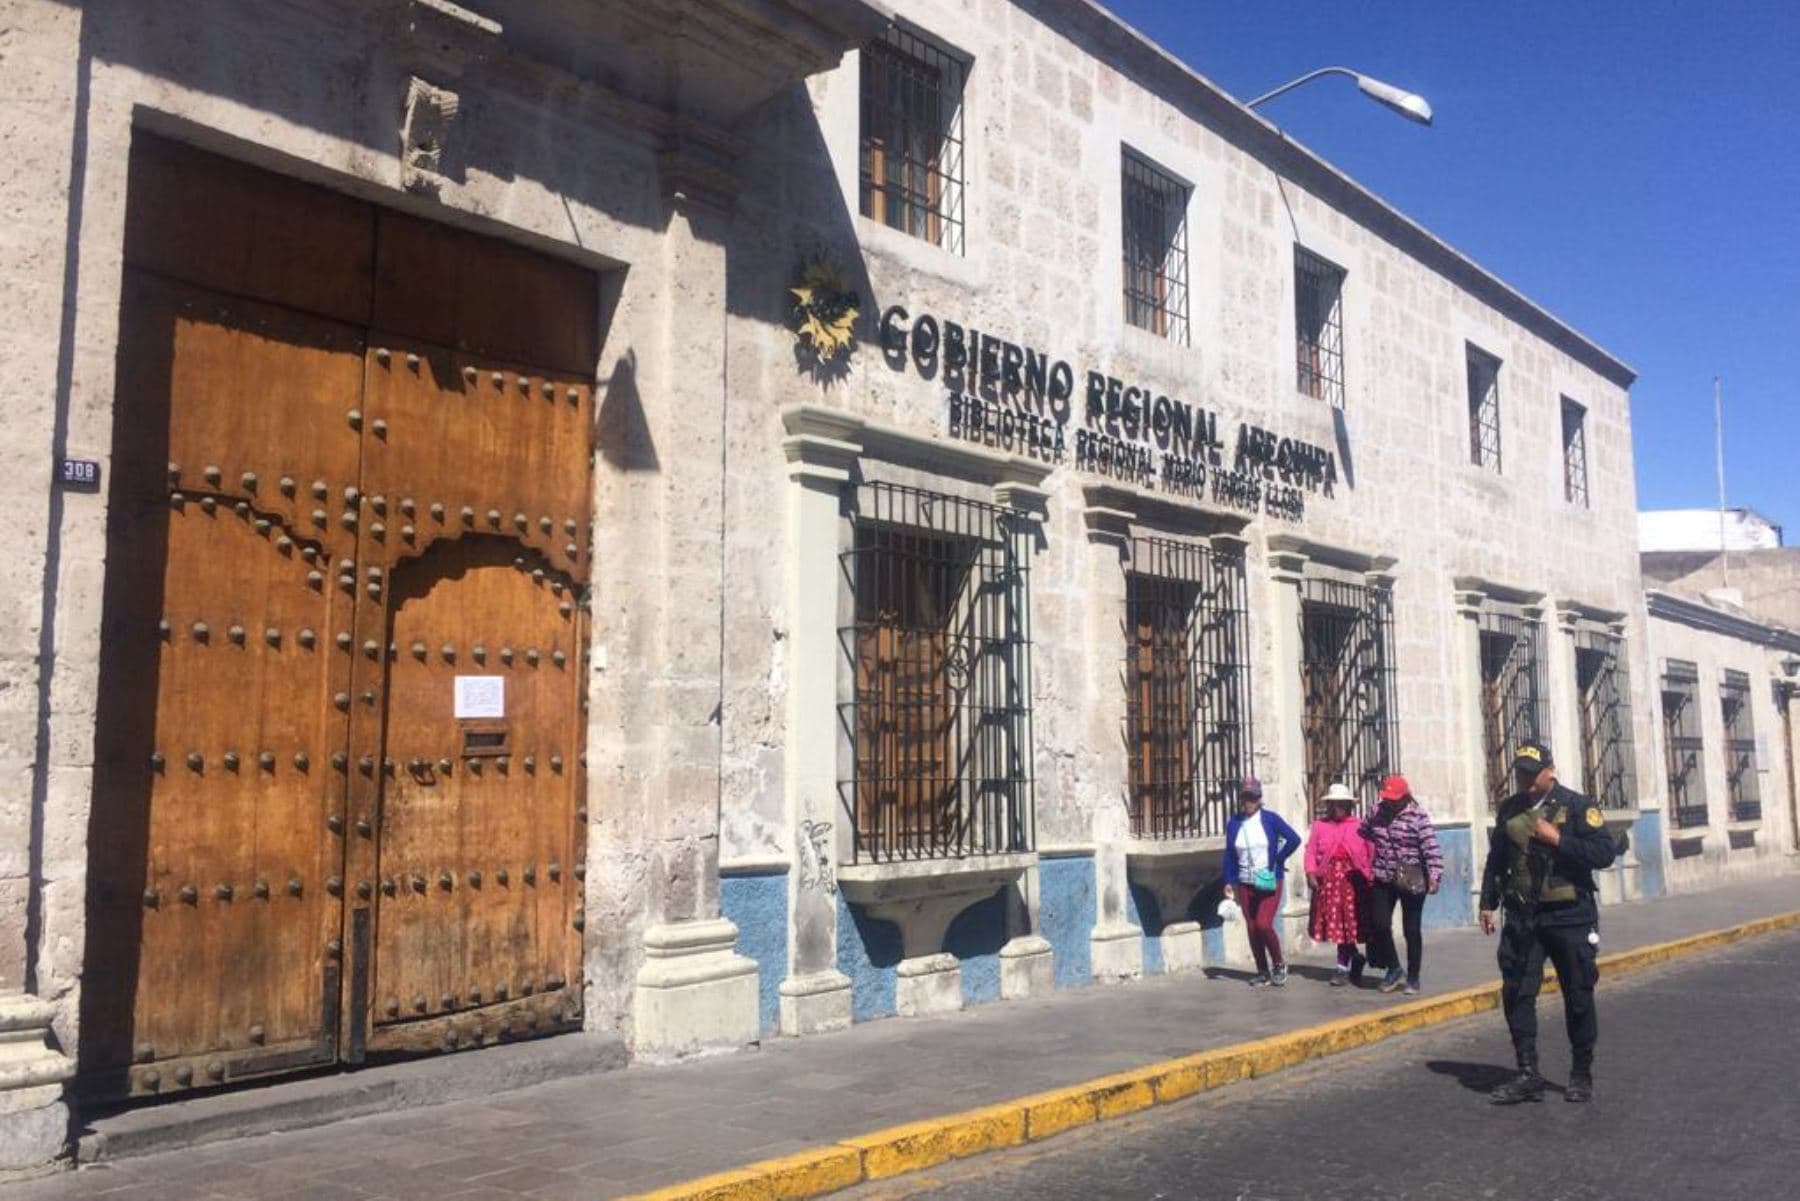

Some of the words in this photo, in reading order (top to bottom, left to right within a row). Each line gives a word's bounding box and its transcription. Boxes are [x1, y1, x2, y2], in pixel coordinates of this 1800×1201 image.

[881, 305, 1073, 406] GOBIERNO
[1086, 371, 1224, 452] REGIONAL
[1235, 423, 1338, 487] AREQUIPA
[949, 391, 1065, 455] BIBLIOTECA
[1076, 428, 1156, 477] REGIONAL
[1161, 453, 1205, 490] MARIO
[1210, 466, 1261, 504] VARGAS
[1264, 481, 1304, 515] LLOSA
[64, 461, 94, 478] 308
